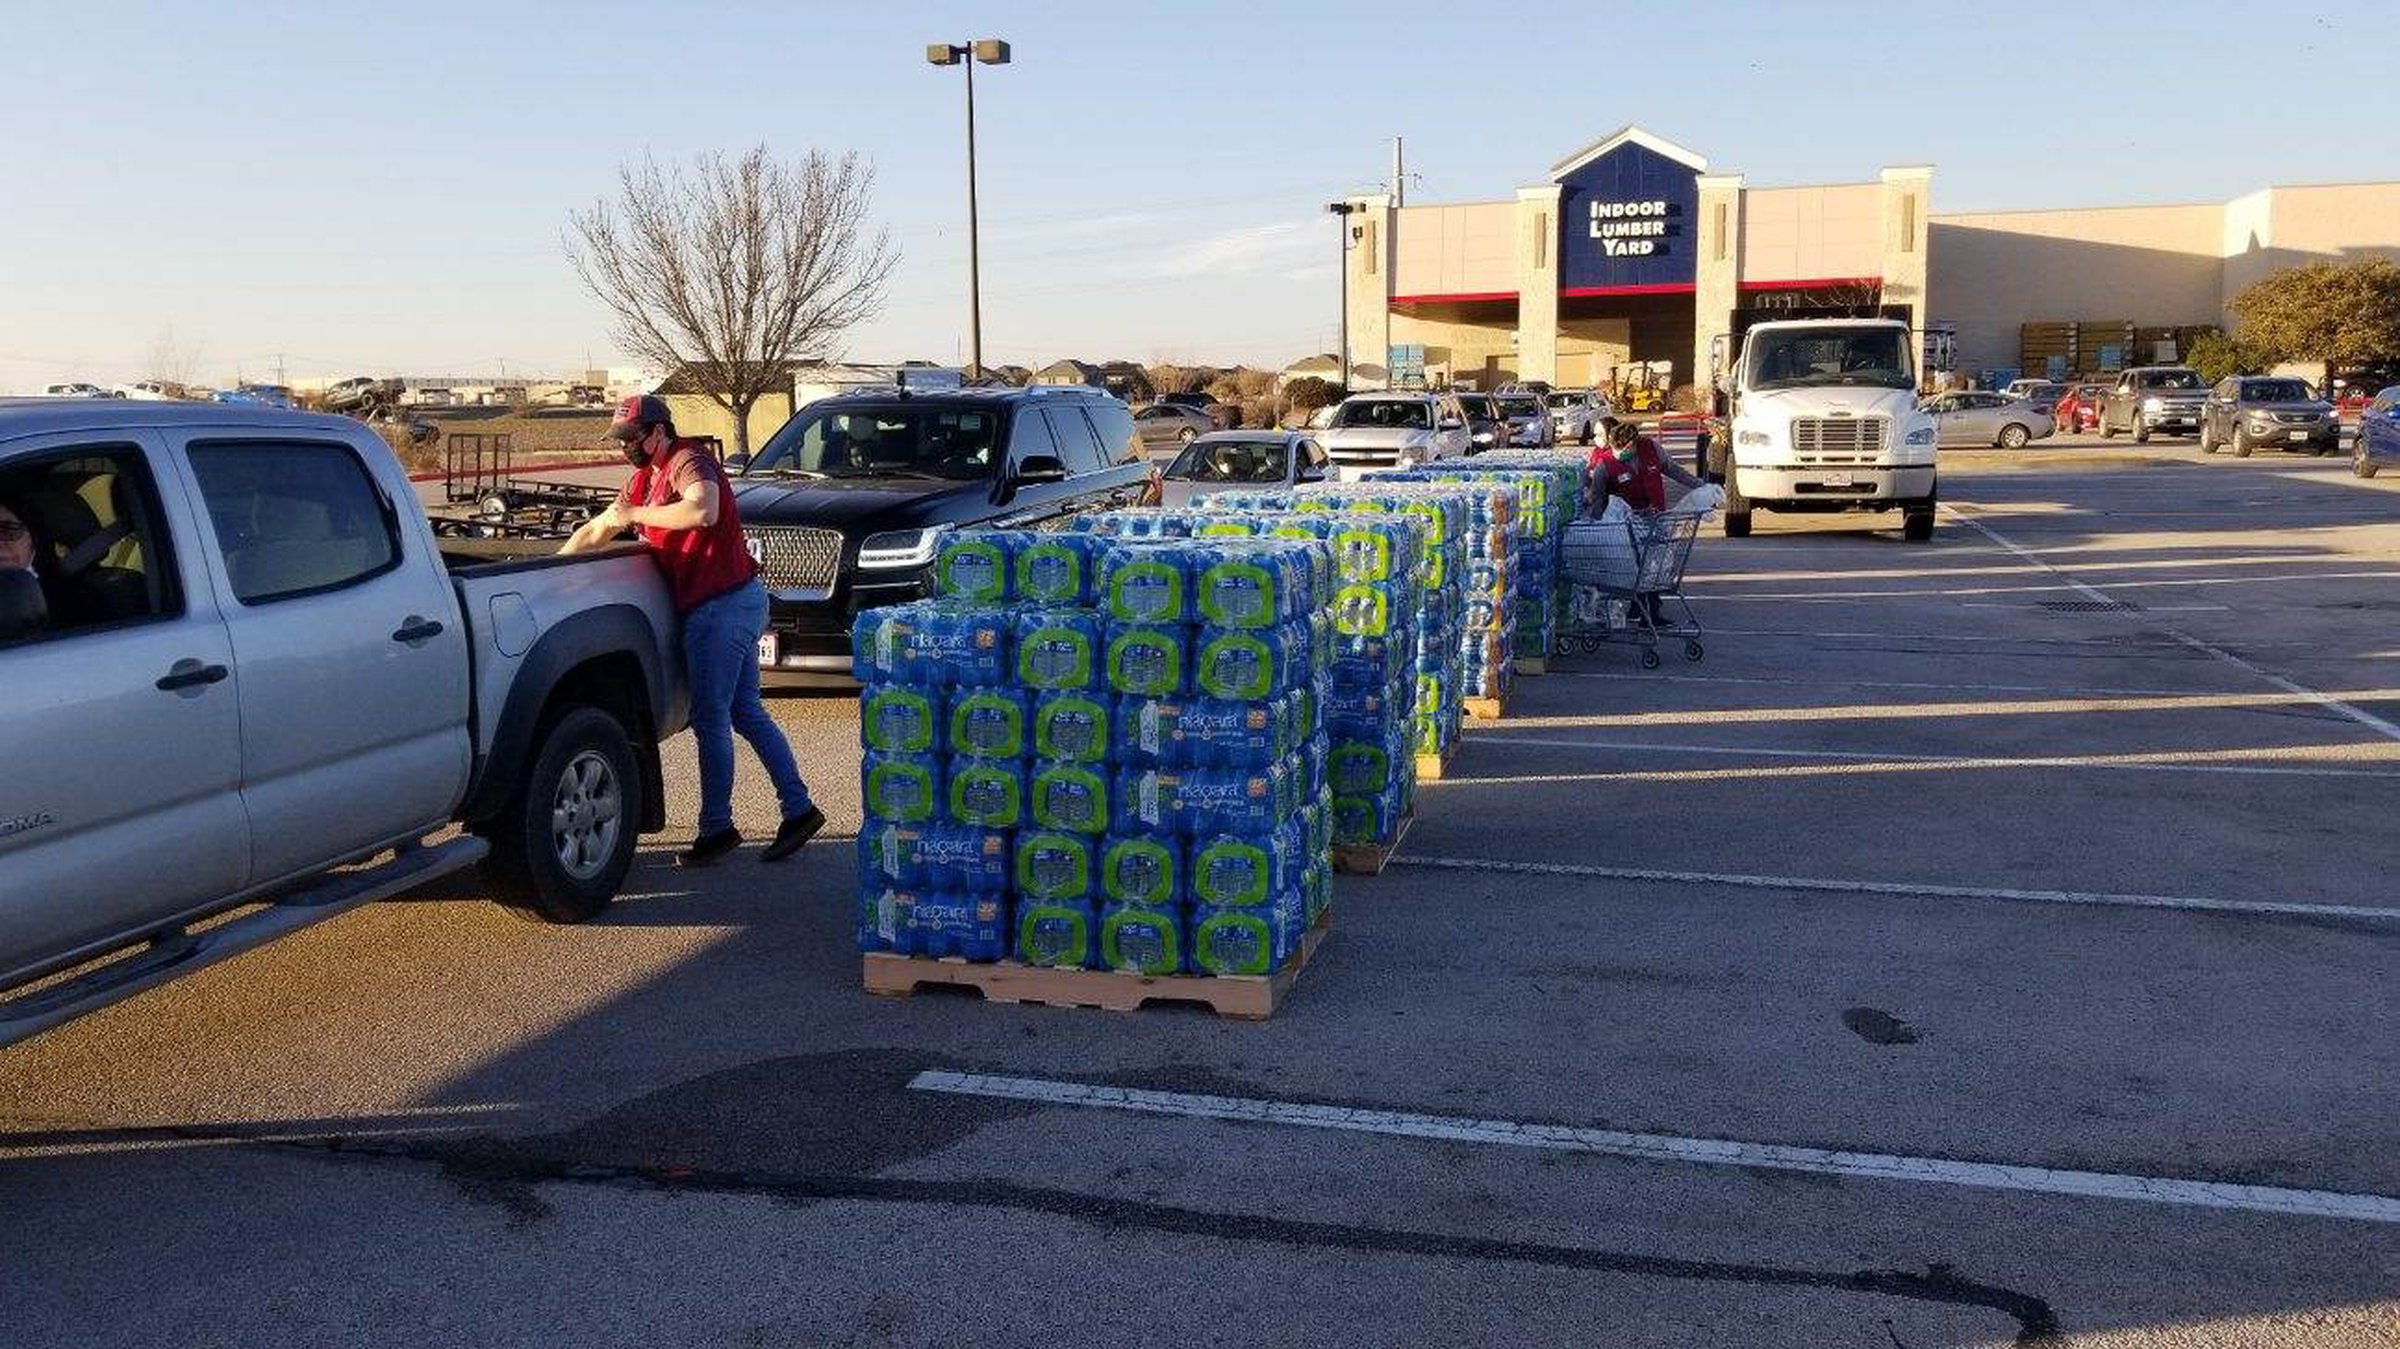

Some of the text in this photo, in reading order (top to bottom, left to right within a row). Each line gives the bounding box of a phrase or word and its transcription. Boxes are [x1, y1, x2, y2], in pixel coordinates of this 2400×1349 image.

[1590, 201, 1666, 218] INDOOR
[1590, 220, 1665, 238] LUMBER
[1602, 239, 1654, 256] YARD
